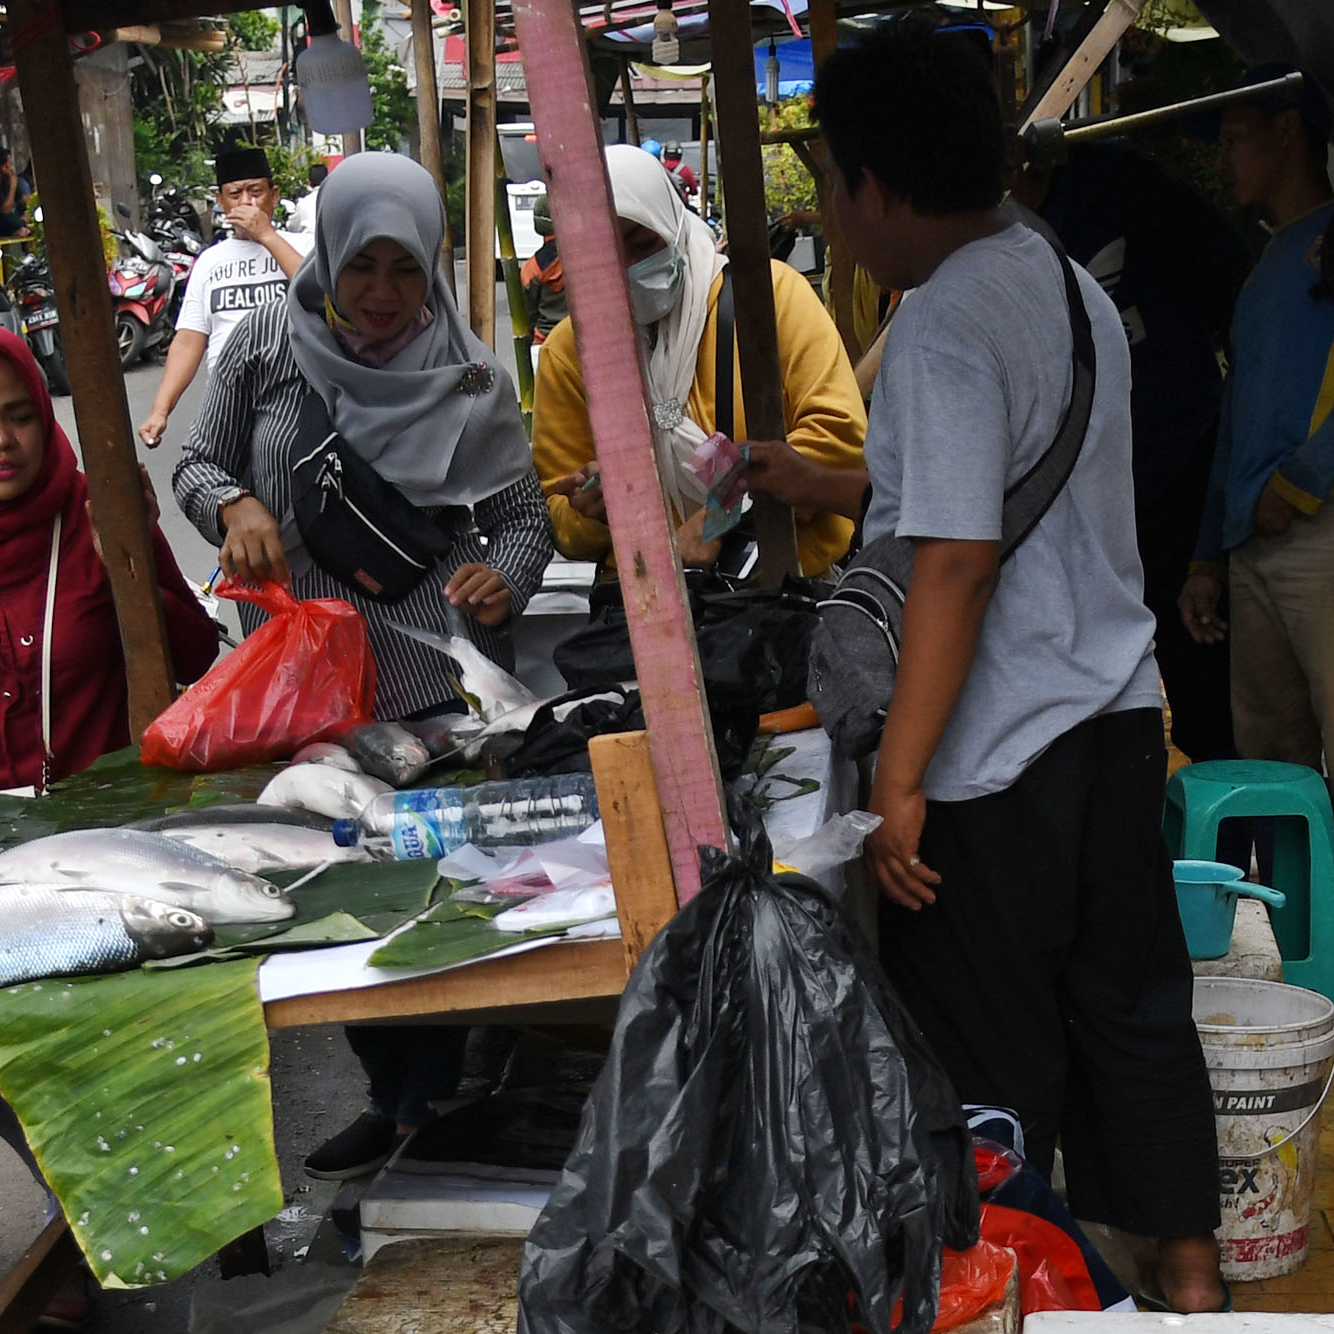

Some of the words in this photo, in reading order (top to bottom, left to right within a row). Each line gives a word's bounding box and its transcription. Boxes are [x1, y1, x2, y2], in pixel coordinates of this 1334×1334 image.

[262, 257, 278, 274] JU
[216, 283, 286, 309] JEALOUS
[1226, 1095, 1276, 1110] PAINT
